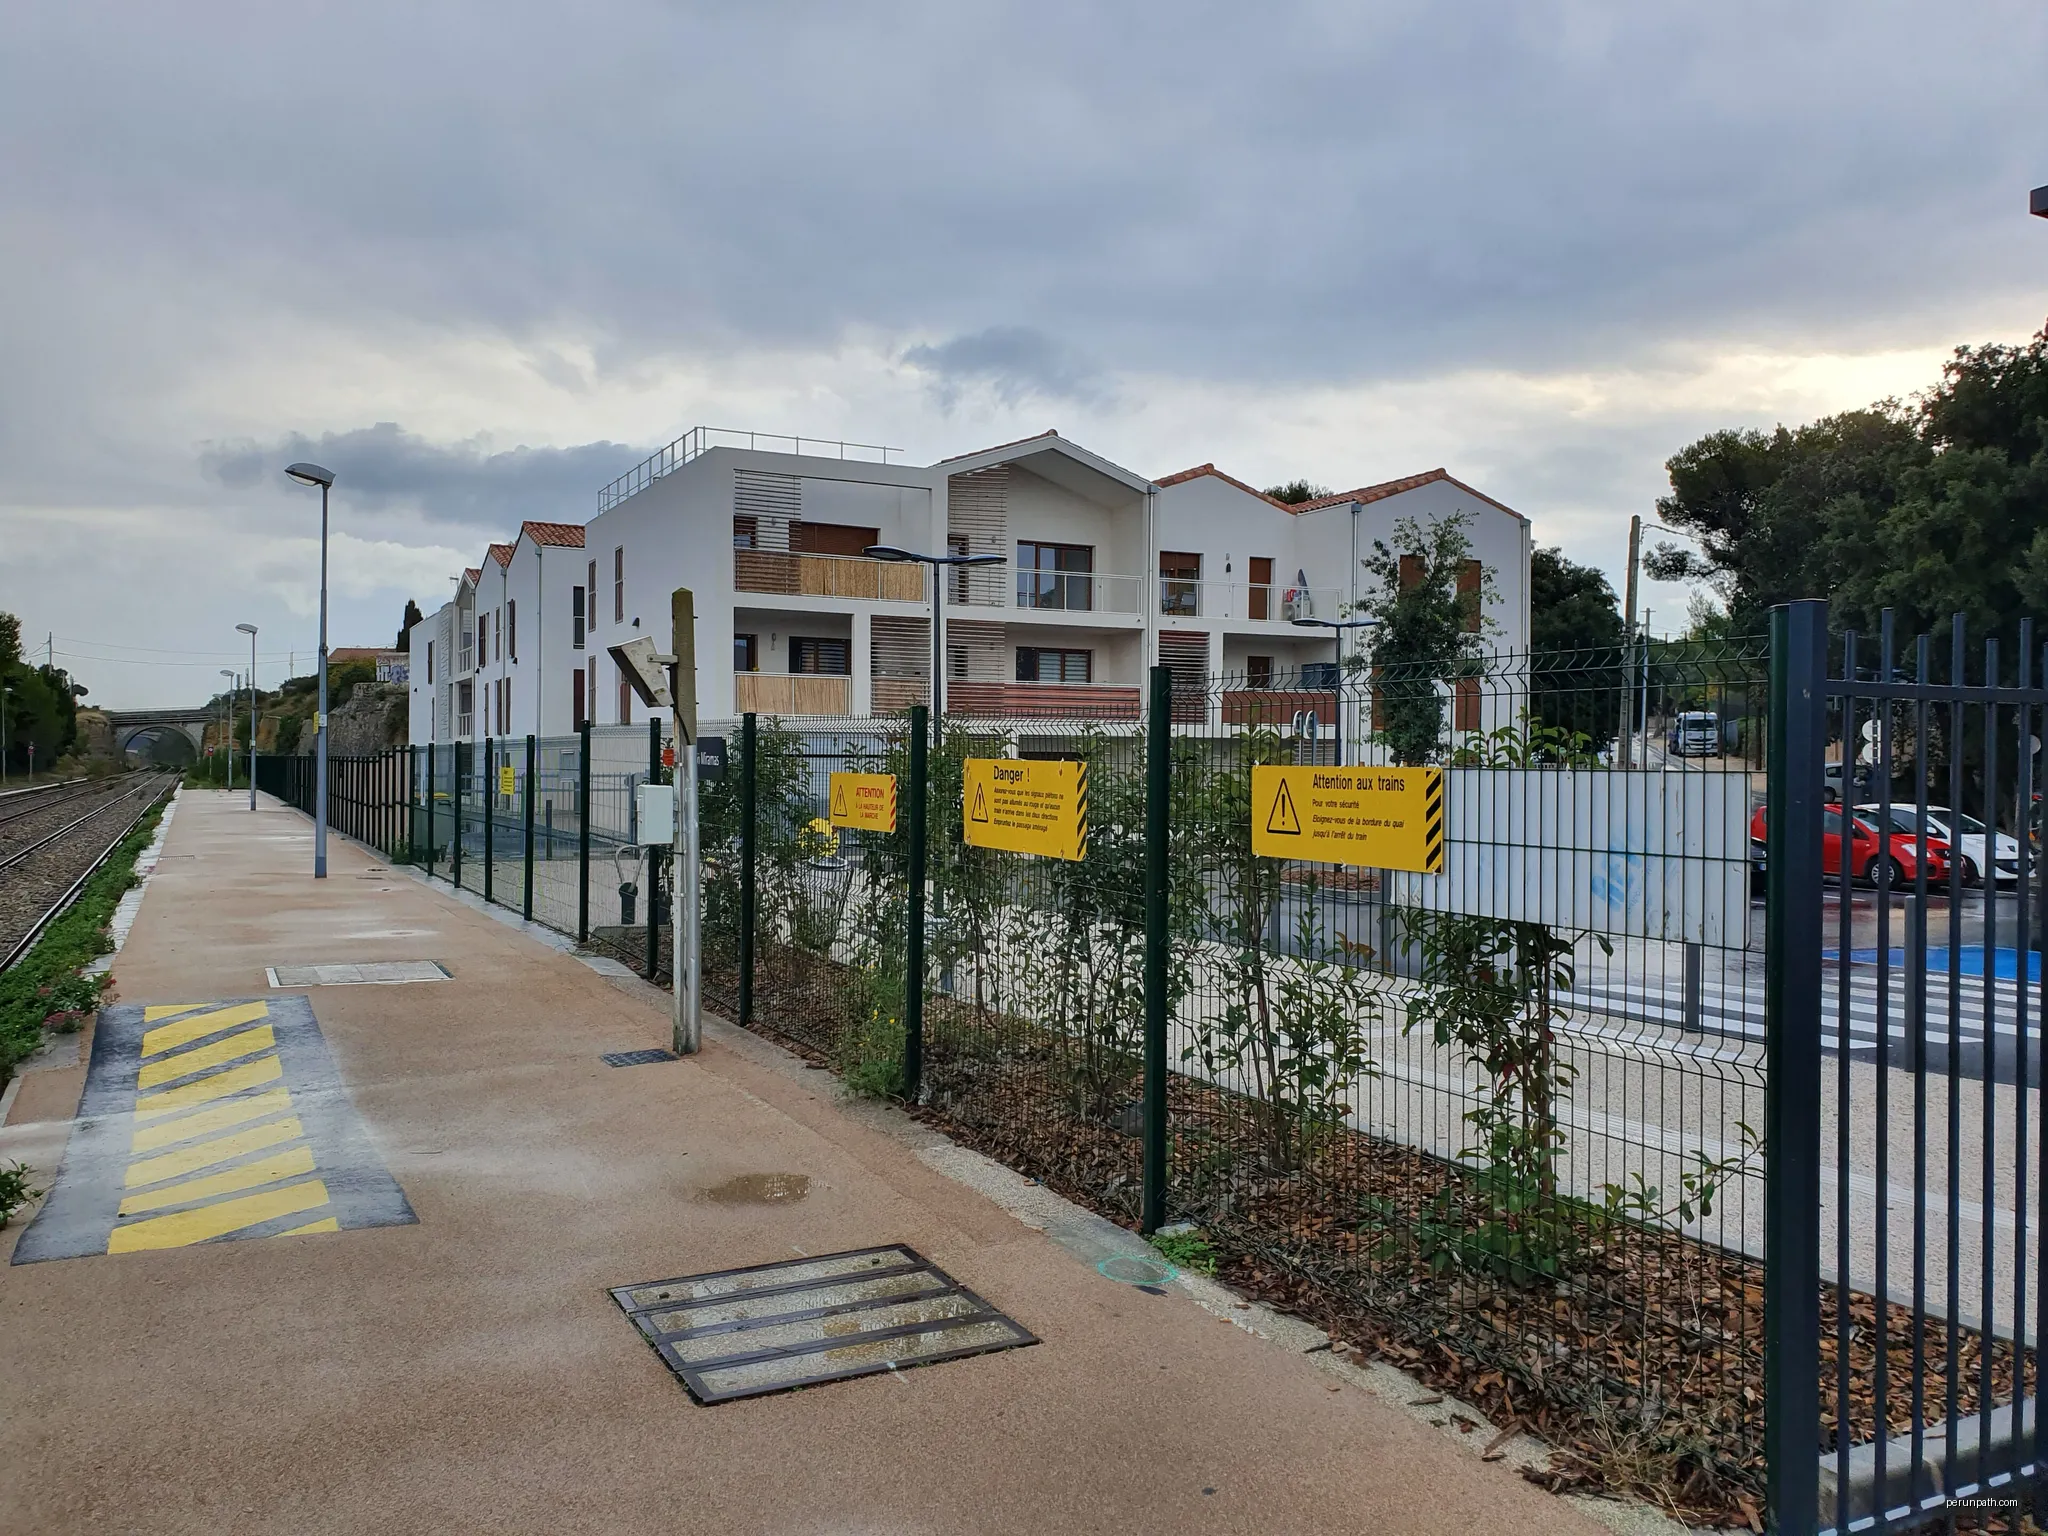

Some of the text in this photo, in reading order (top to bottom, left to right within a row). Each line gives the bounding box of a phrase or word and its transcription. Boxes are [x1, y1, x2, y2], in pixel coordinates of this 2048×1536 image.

[994, 766, 1023, 784] Danger
[1313, 774, 1405, 792] Attention aux trains
[856, 787, 884, 799] ATTENTION
[1312, 799, 1359, 809] Pour votre sécurité
[1347, 817, 1354, 825] de
[1356, 817, 1361, 825] la
[1362, 817, 1382, 826] bordure
[1384, 819, 1391, 827] du
[1392, 820, 1405, 829] quai
[1331, 831, 1346, 839] l'arrêt
[1347, 831, 1354, 839] du
